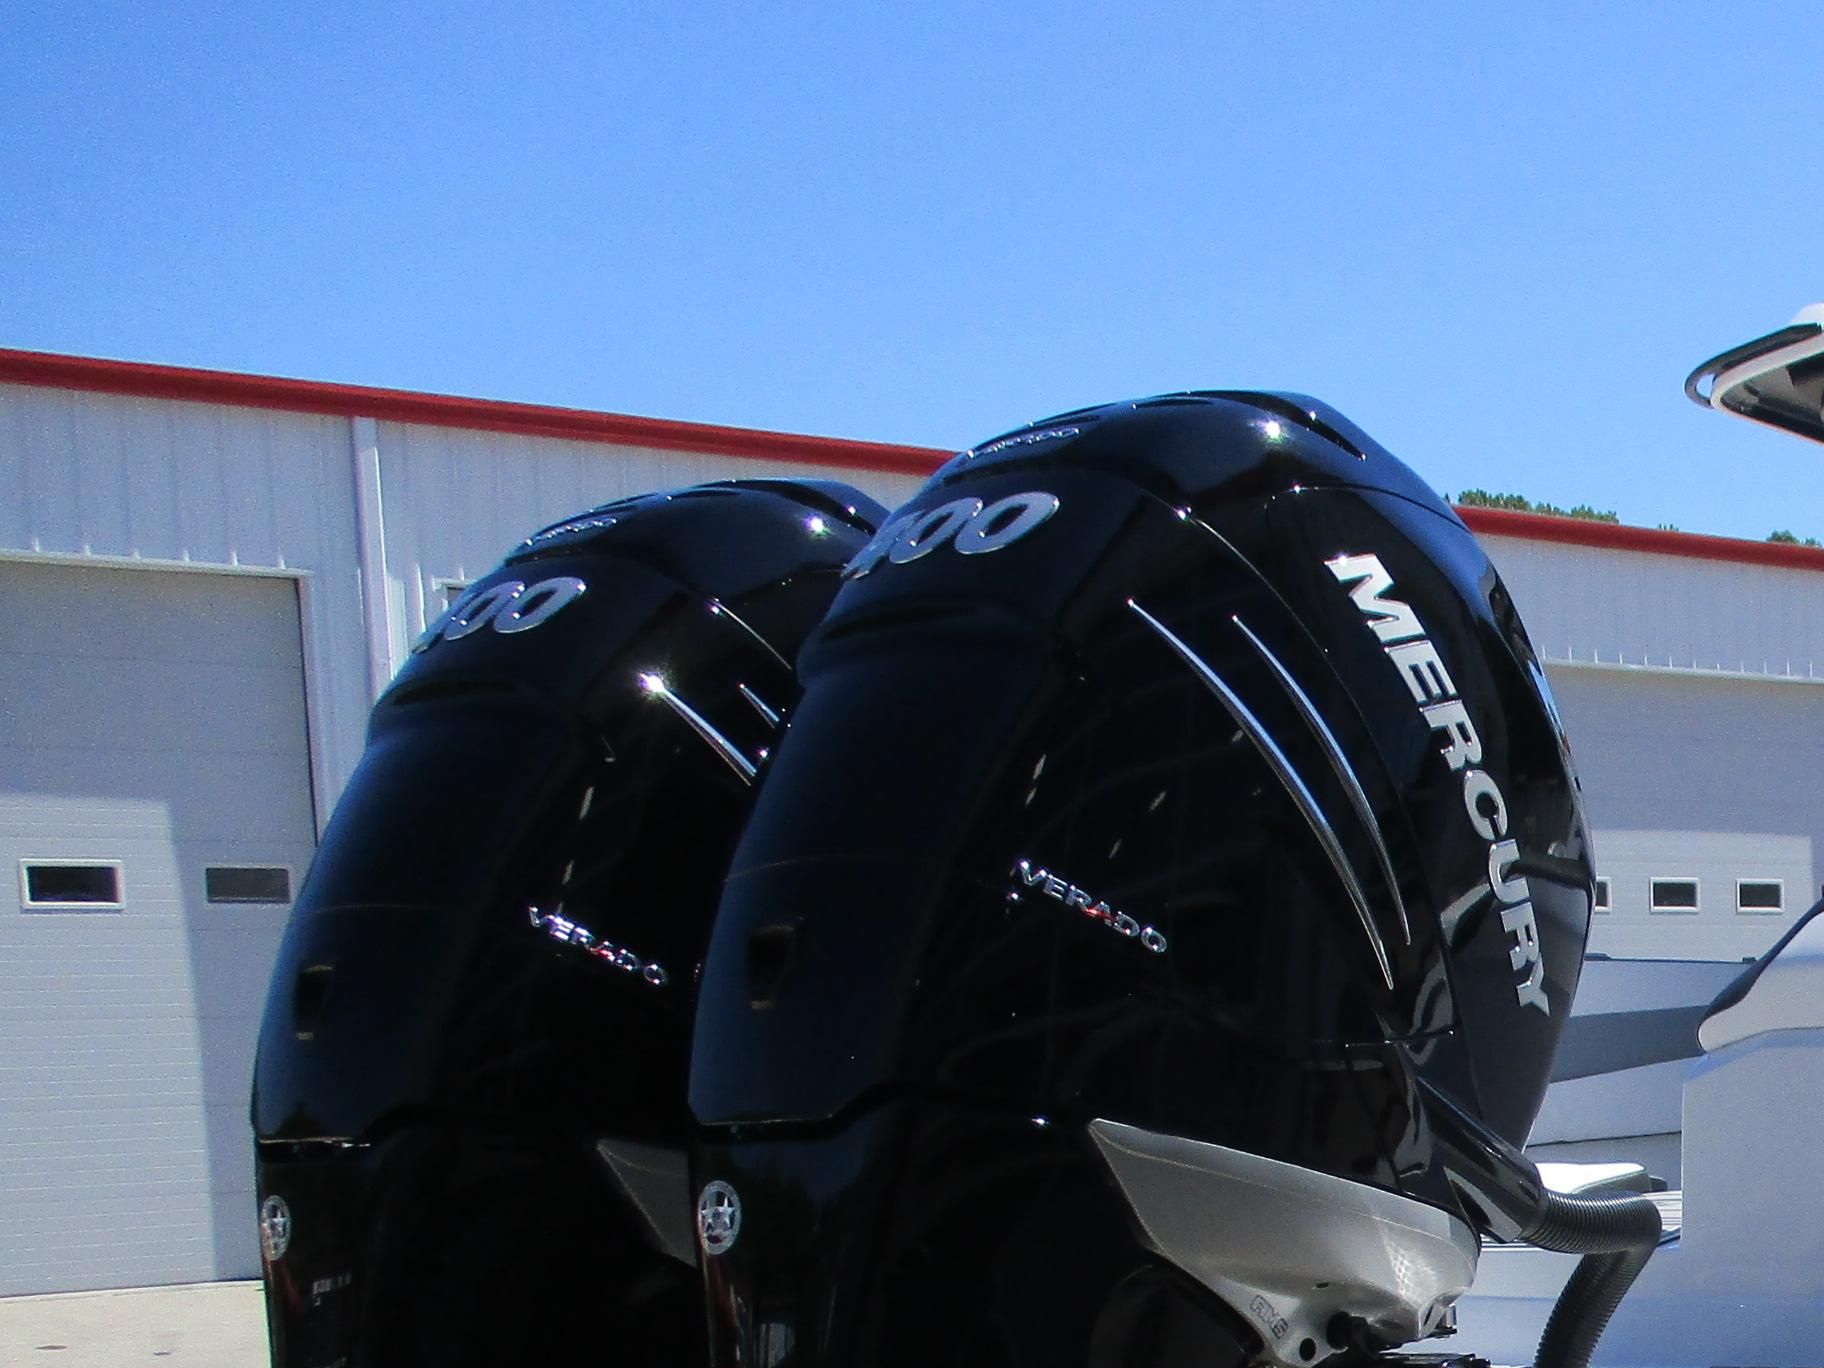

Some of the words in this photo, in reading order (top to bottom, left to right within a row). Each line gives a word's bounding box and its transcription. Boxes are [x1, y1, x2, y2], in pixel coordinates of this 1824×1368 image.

[1324, 553, 1551, 1017] MERCURY
[529, 906, 667, 985] VERADO
[1019, 860, 1167, 953] VERADO
